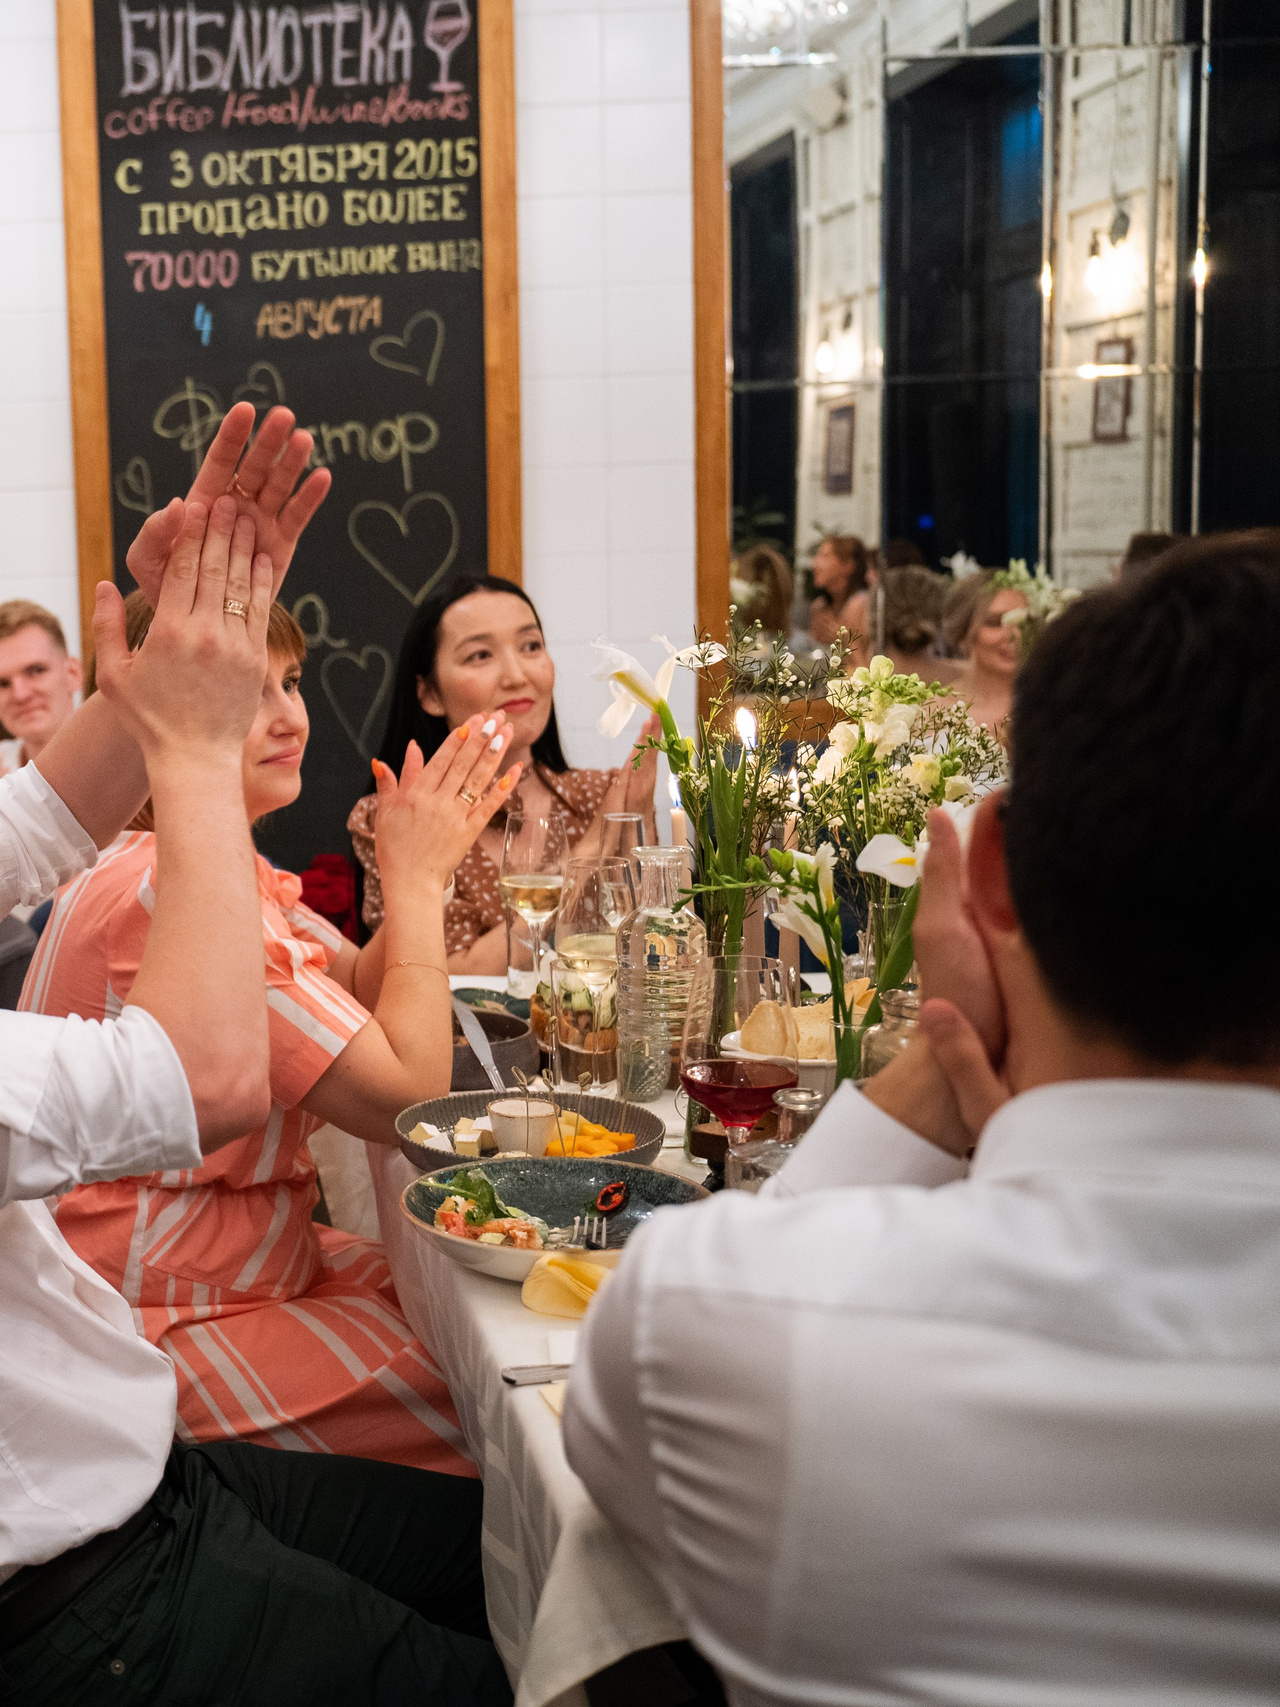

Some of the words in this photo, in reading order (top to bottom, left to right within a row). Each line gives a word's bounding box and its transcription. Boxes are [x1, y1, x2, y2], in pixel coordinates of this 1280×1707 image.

[121, 2, 415, 96] БИБЛИОТЕКА
[169, 149, 195, 188] 3
[201, 141, 388, 188] ОКТЯБРЯ
[392, 136, 480, 180] 2015
[342, 182, 468, 226] БОЛЕЕ
[124, 248, 239, 292] 70000
[251, 243, 399, 282] БУТЫЛОК
[194, 302, 213, 346] 4
[255, 295, 383, 340] АВГУСТА
